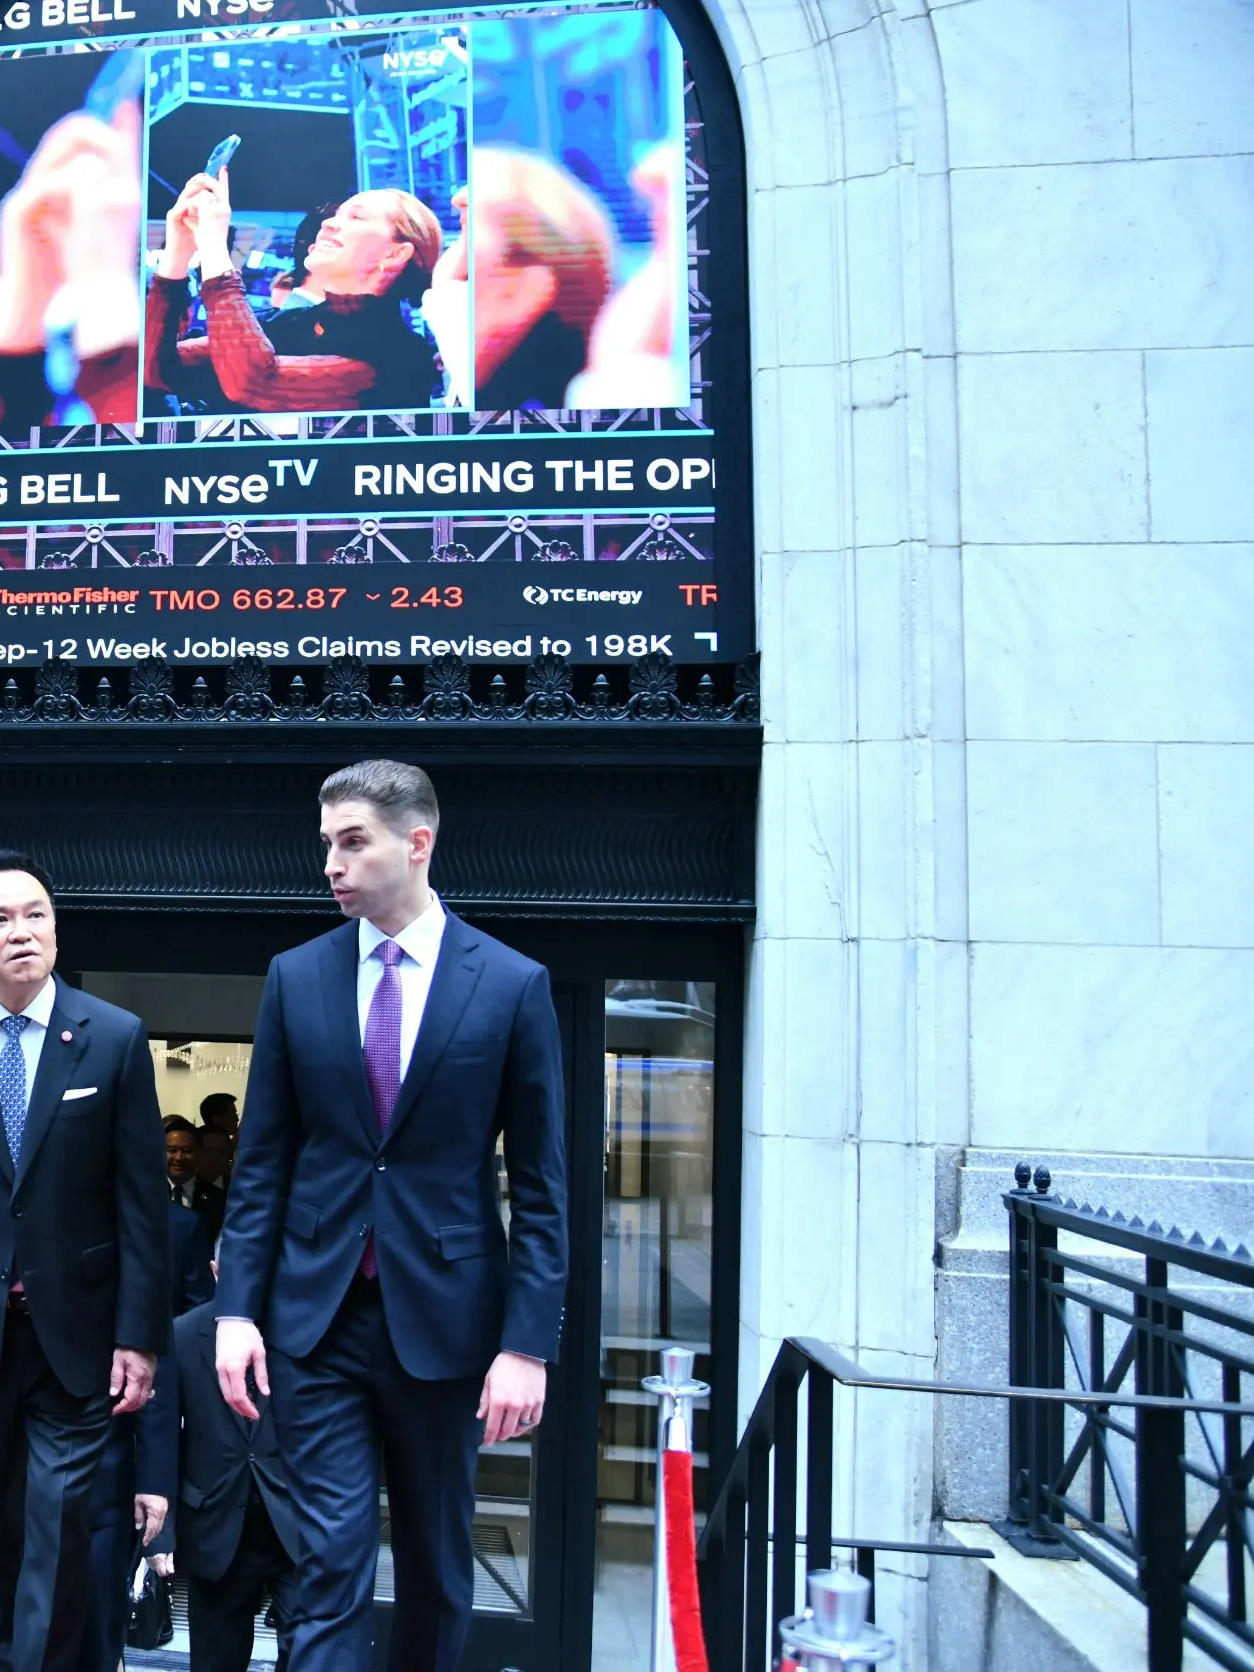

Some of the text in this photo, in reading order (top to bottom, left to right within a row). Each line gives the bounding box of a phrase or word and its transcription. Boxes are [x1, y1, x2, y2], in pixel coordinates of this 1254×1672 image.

[41, 0, 136, 27] BELL
[20, 472, 120, 504] BELL
[354, 457, 716, 495] RINGING THE OP
[150, 586, 464, 611] TMO 662.87 2.43
[86, 637, 167, 660] Week
[173, 635, 290, 658] Jobless
[297, 634, 402, 657] Claims
[410, 634, 532, 657] Revised
[539, 636, 572, 656] to
[585, 634, 673, 657] 198K
